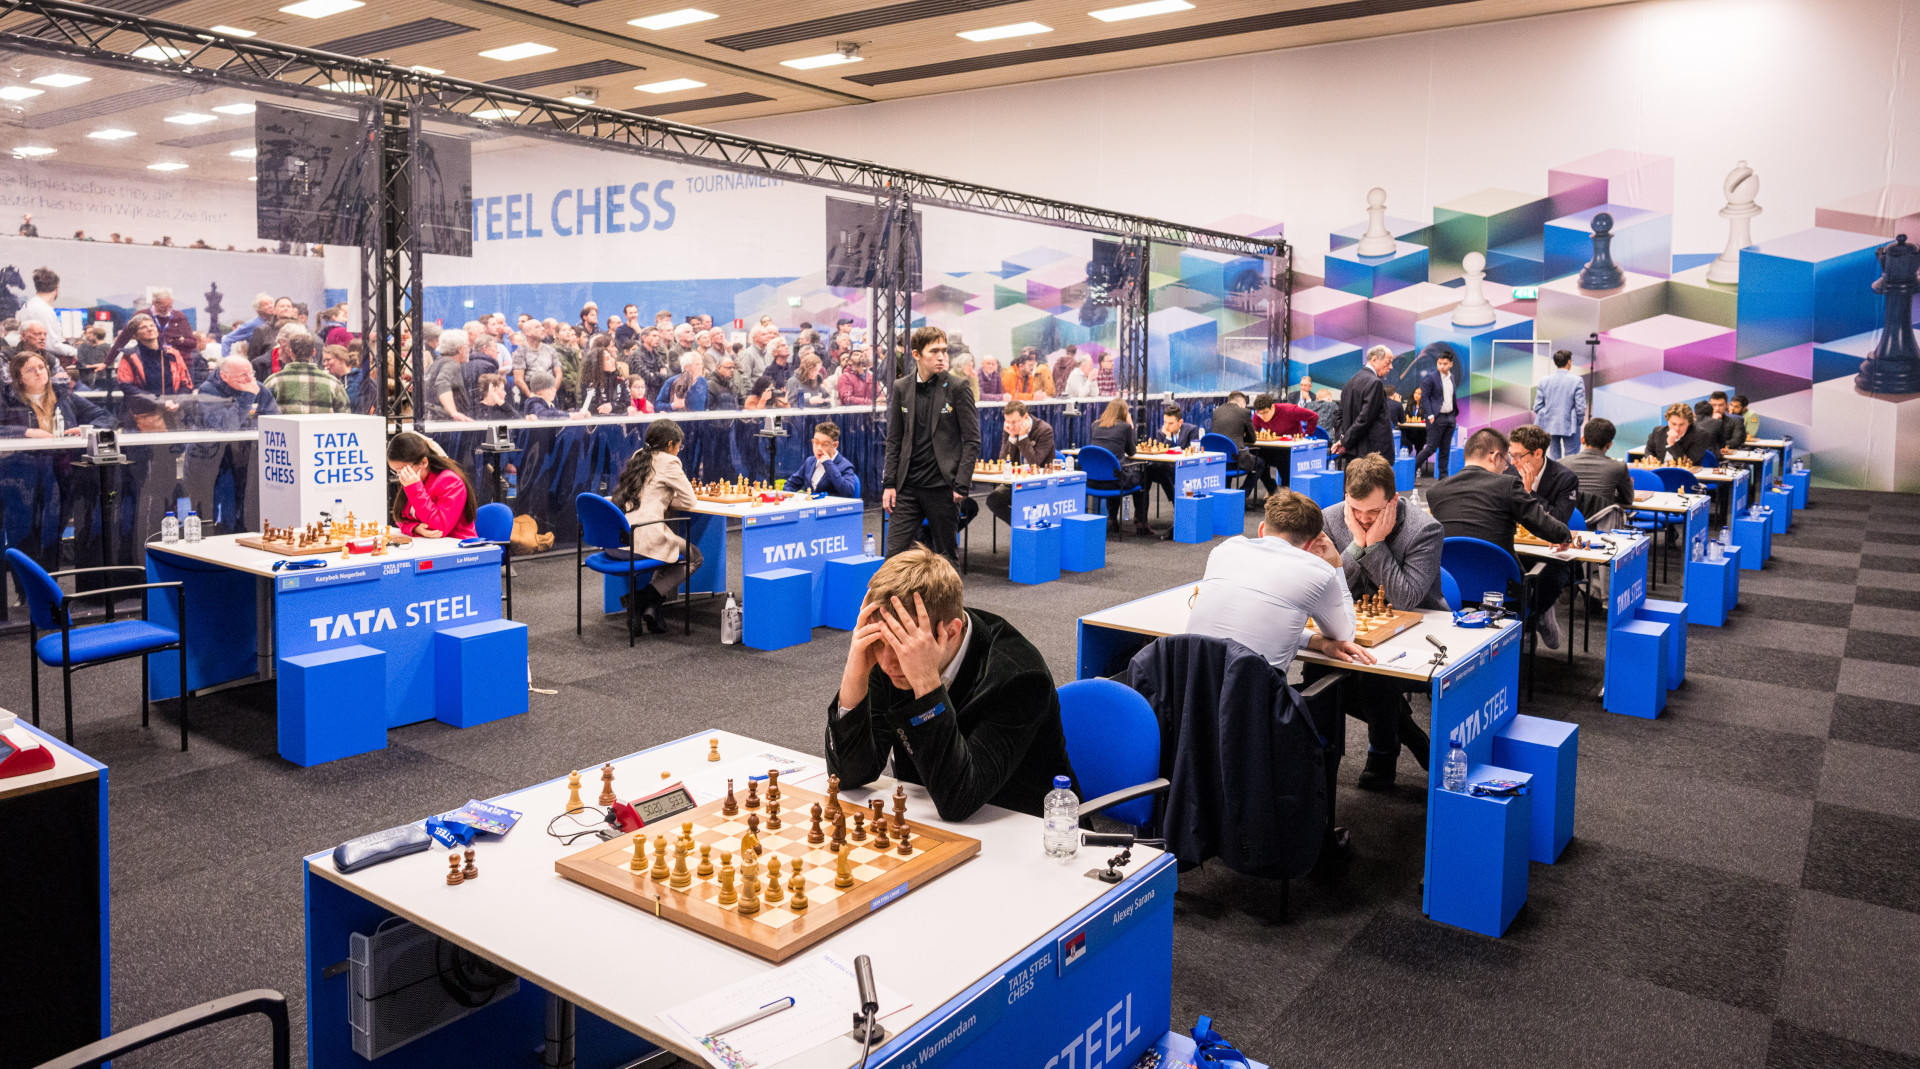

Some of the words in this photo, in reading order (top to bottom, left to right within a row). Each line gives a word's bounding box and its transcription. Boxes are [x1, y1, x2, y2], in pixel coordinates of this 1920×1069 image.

[472, 192, 543, 242] TEEL
[551, 179, 676, 237] CHESS
[264, 430, 287, 448] TATA
[313, 432, 359, 449] TATA
[264, 448, 292, 466] STEEL
[314, 449, 369, 467] STEEL
[265, 465, 295, 485] CHESS
[314, 466, 374, 485] CHESS
[1203, 475, 1221, 489] STEEL
[1052, 498, 1078, 516] STEEL
[763, 541, 807, 564] TATA
[810, 535, 849, 557] STEEL
[310, 607, 398, 642] TATA
[405, 594, 479, 627] STEEL
[1450, 709, 1480, 749] TATA
[1482, 686, 1508, 730] STEEL
[433, 826, 455, 843] STEEL
[1112, 905, 1134, 926] Alexey
[1134, 889, 1155, 910] Sarana
[1008, 969, 1028, 992] TATA
[1029, 952, 1052, 977] STEEL
[1007, 977, 1035, 1005] CHESS
[918, 1014, 977, 1065] Warmerdam
[1043, 992, 1141, 1069] TEEL
